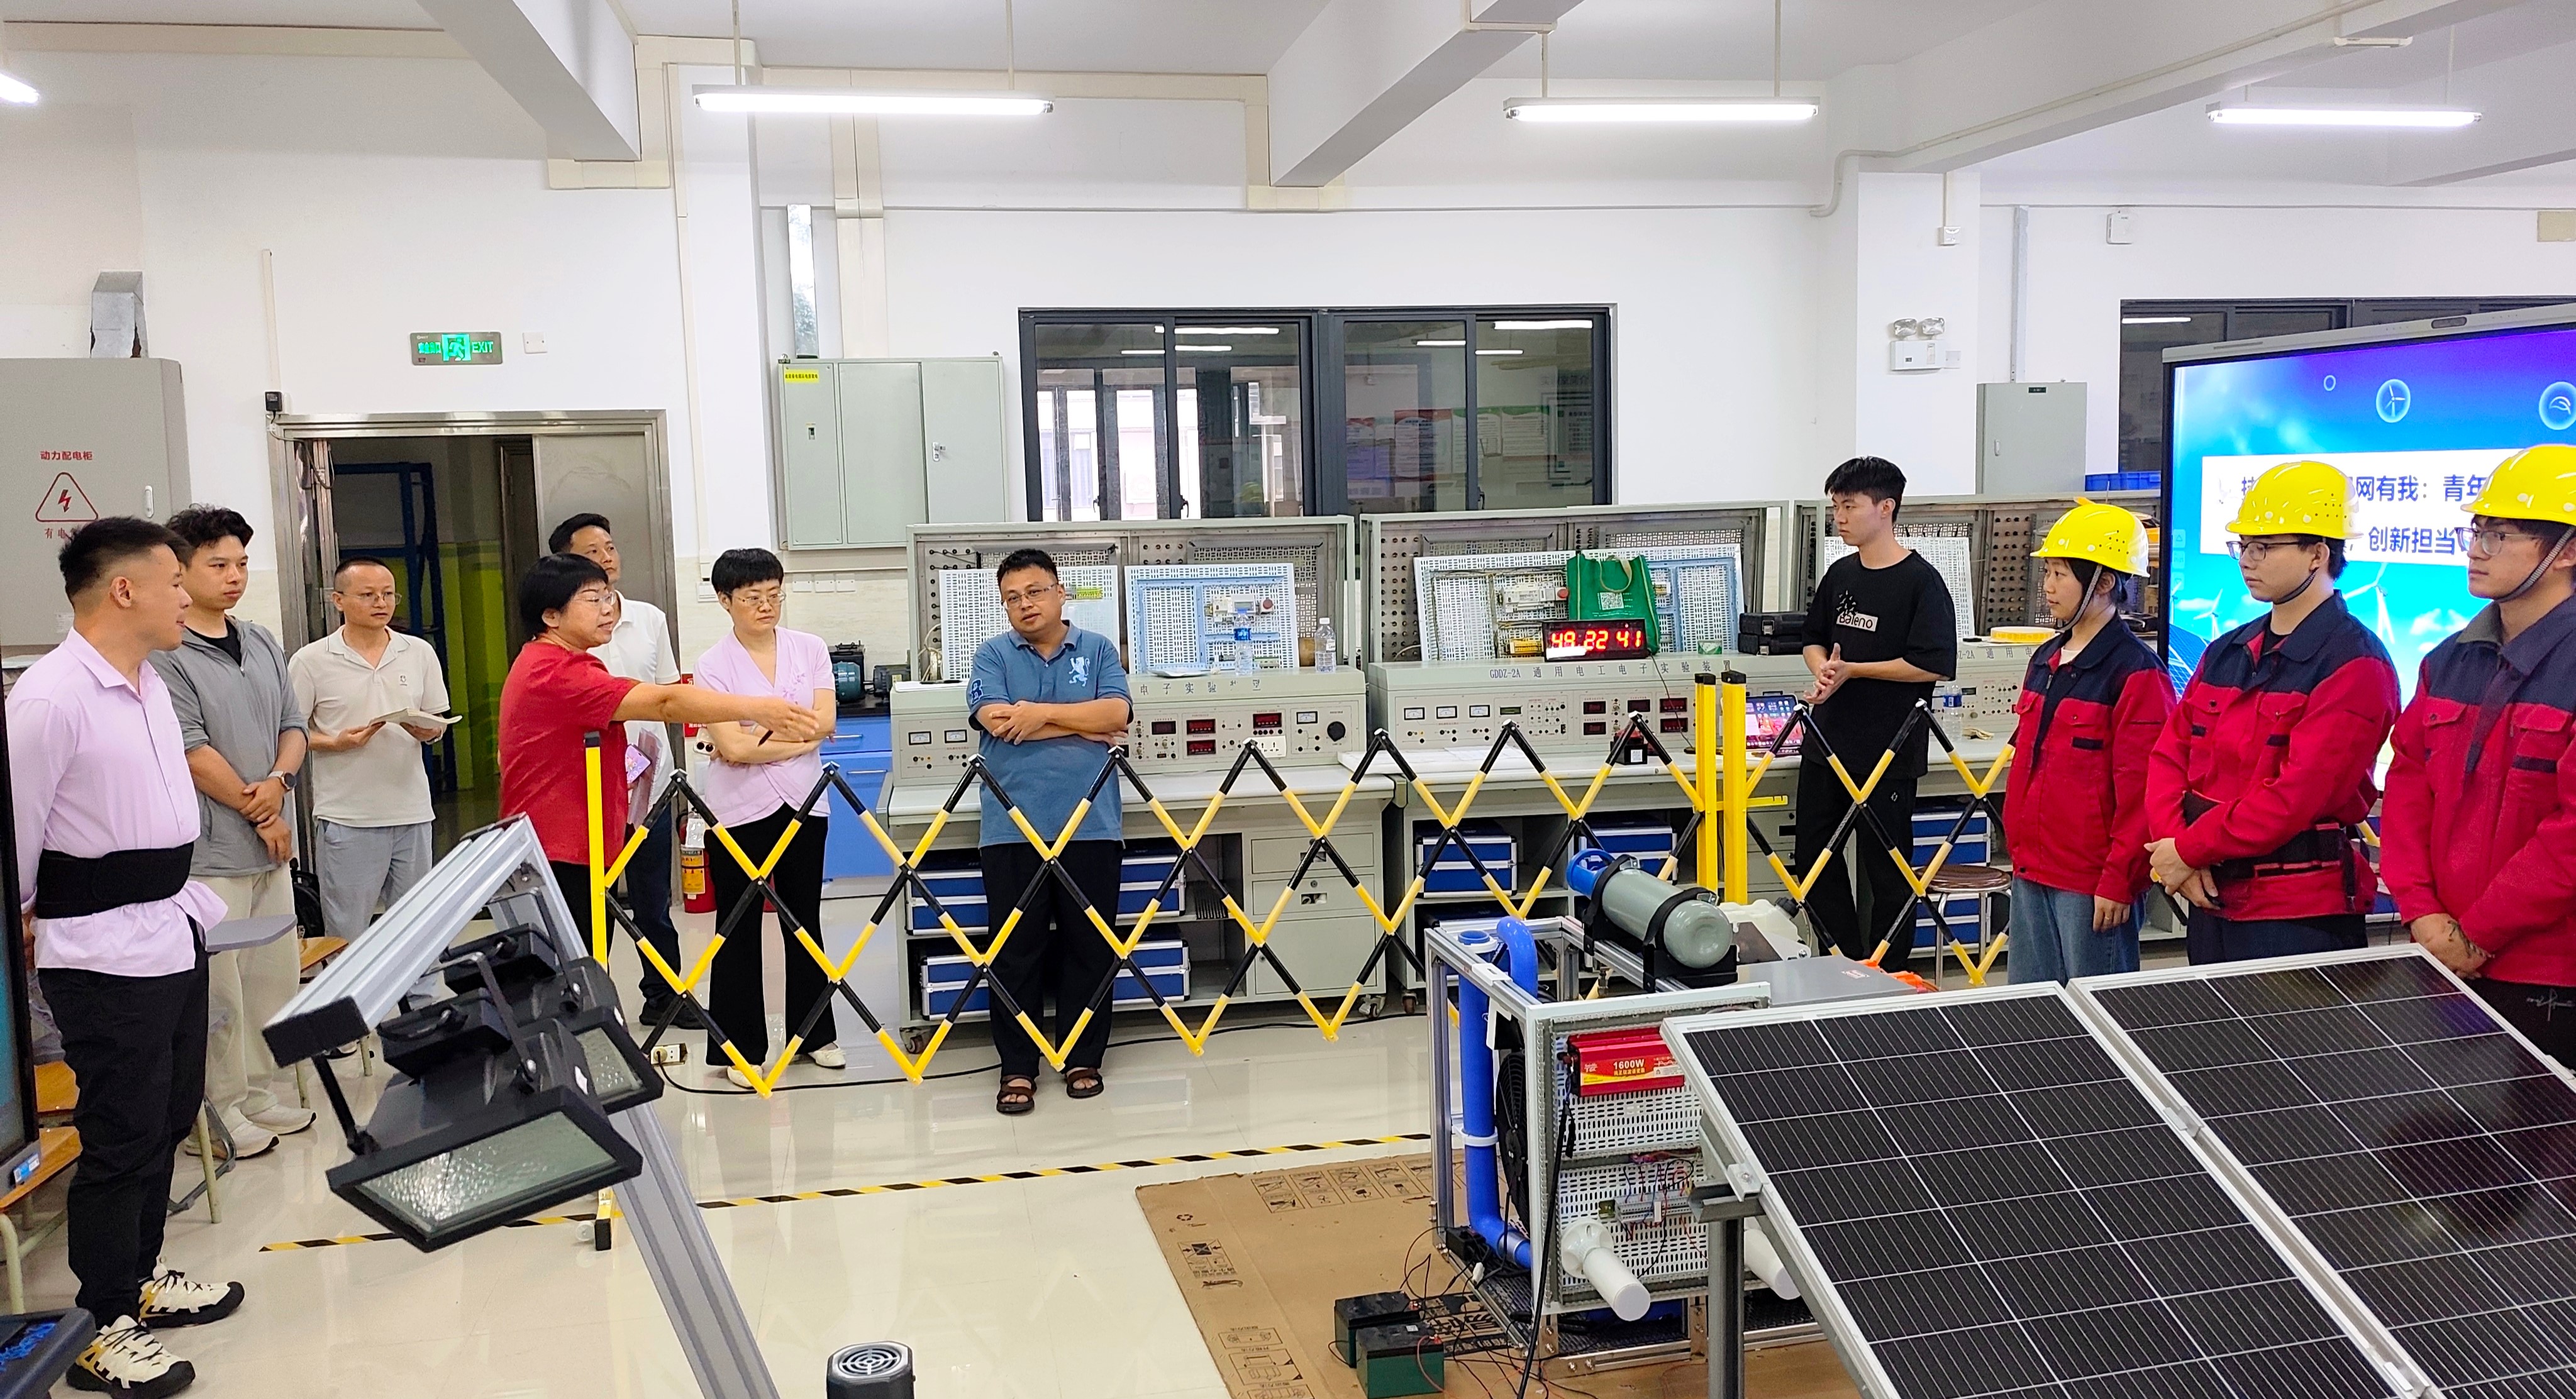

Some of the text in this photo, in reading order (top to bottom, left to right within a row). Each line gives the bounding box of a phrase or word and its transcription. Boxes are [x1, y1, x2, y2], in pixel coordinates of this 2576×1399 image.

[472, 341, 494, 353] EXIT
[40, 450, 93, 460] 动力配电柜
[2350, 474, 2489, 502] 网有我：青年
[1839, 614, 1874, 629] Baleno
[1489, 668, 1521, 678] GDDZ-2A
[1613, 1058, 1645, 1070] 1600W
